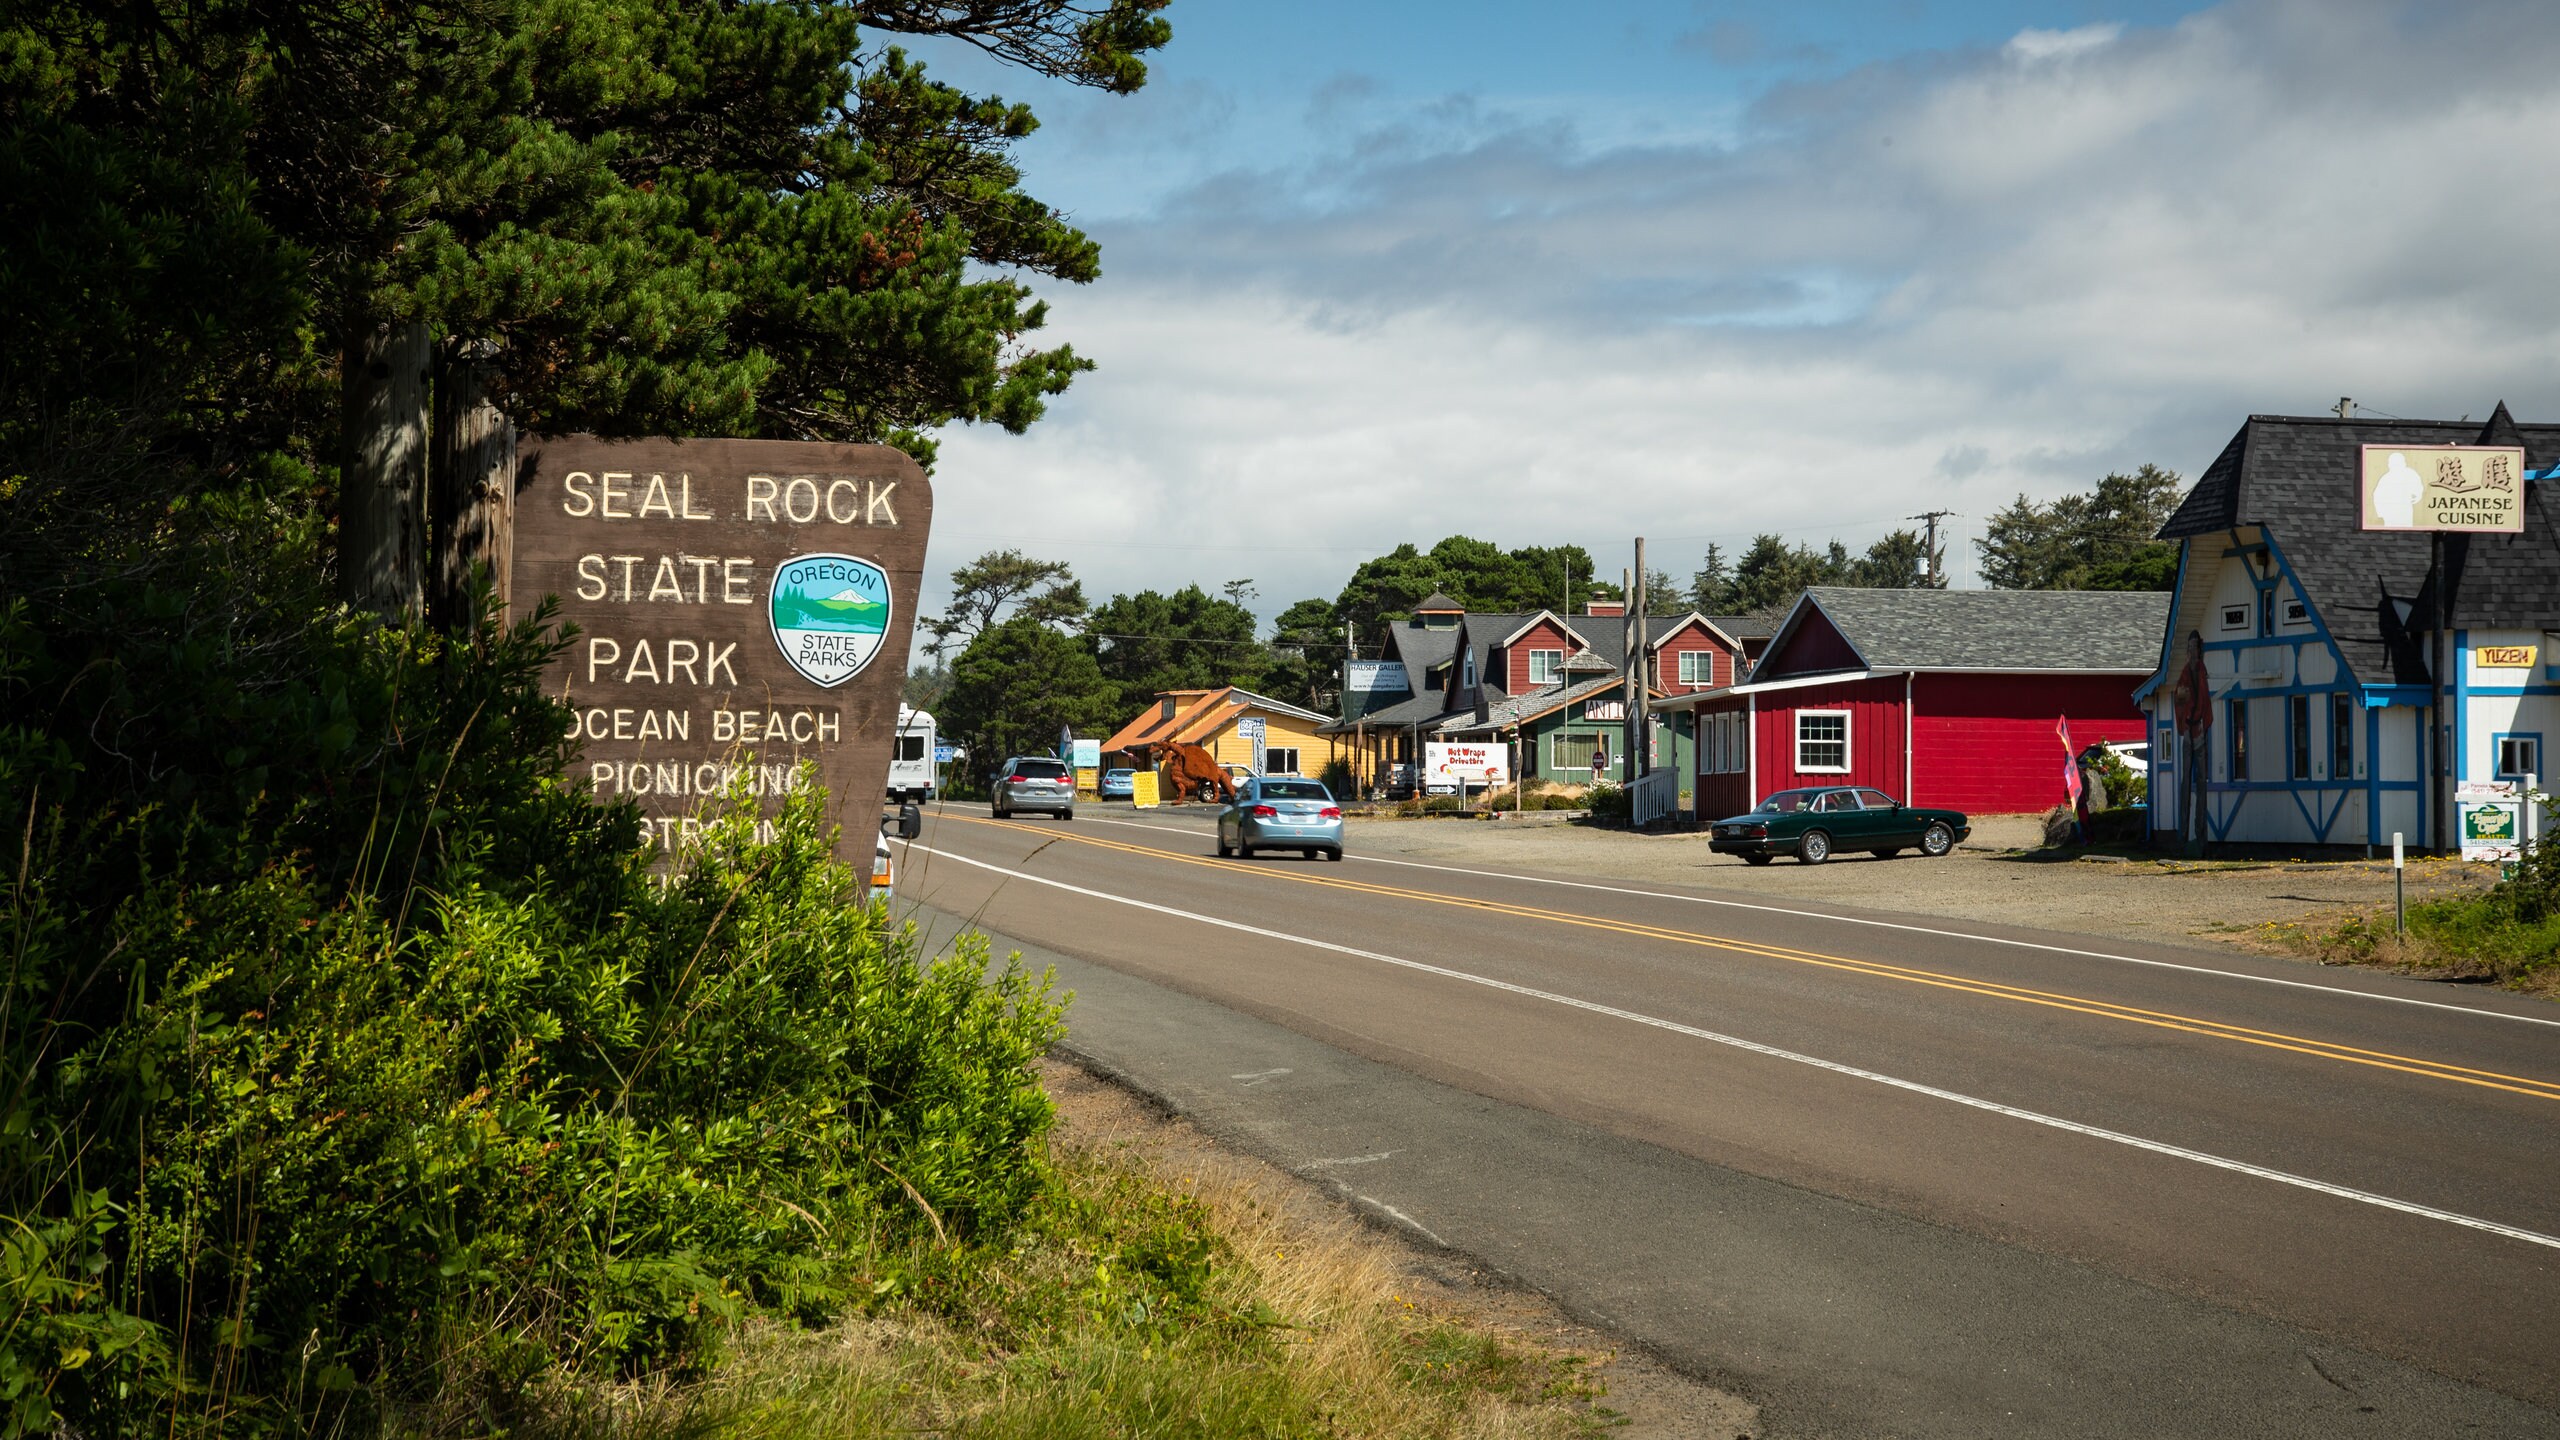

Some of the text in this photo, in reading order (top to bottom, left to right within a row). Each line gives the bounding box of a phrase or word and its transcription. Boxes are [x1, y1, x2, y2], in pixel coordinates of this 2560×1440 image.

[563, 471, 898, 525] SEAL ROCK
[2428, 497, 2513, 510] JAPANESE
[2437, 512, 2504, 525] CUISINE
[577, 554, 754, 604] STATE
[789, 565, 877, 590] OREGON
[802, 634, 855, 651] STATE
[589, 638, 738, 686] PARK
[799, 650, 857, 668] PARKS
[2484, 648, 2529, 664] YUZEN
[713, 711, 840, 743] BEACH
[591, 762, 803, 796] PICNICKING
